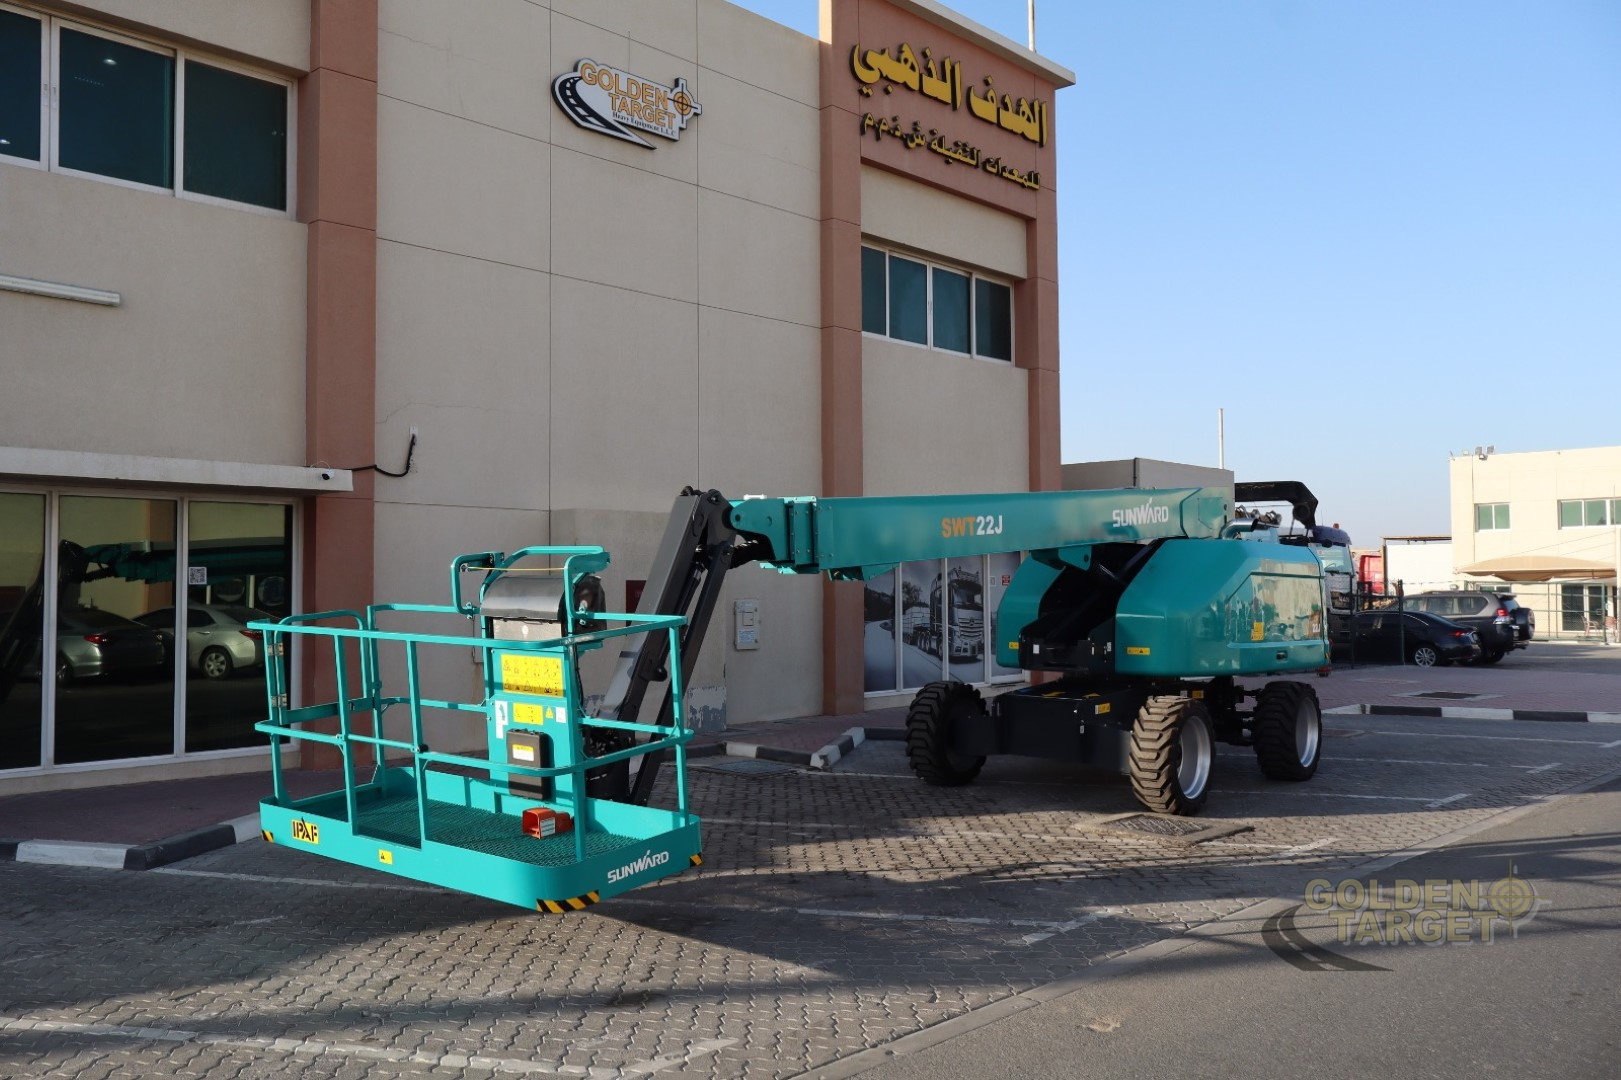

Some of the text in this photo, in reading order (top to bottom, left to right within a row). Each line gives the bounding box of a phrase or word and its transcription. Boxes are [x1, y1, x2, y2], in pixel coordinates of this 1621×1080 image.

[580, 62, 669, 110] GOLDEN
[851, 42, 1048, 147] الهدف الذهبي
[608, 93, 676, 129] TARGET
[612, 111, 629, 122] Heavy
[941, 514, 1003, 539] SWT22J
[1112, 496, 1169, 528] SUNWARD
[292, 816, 318, 842] IPAF
[607, 849, 670, 884] SUNWARD
